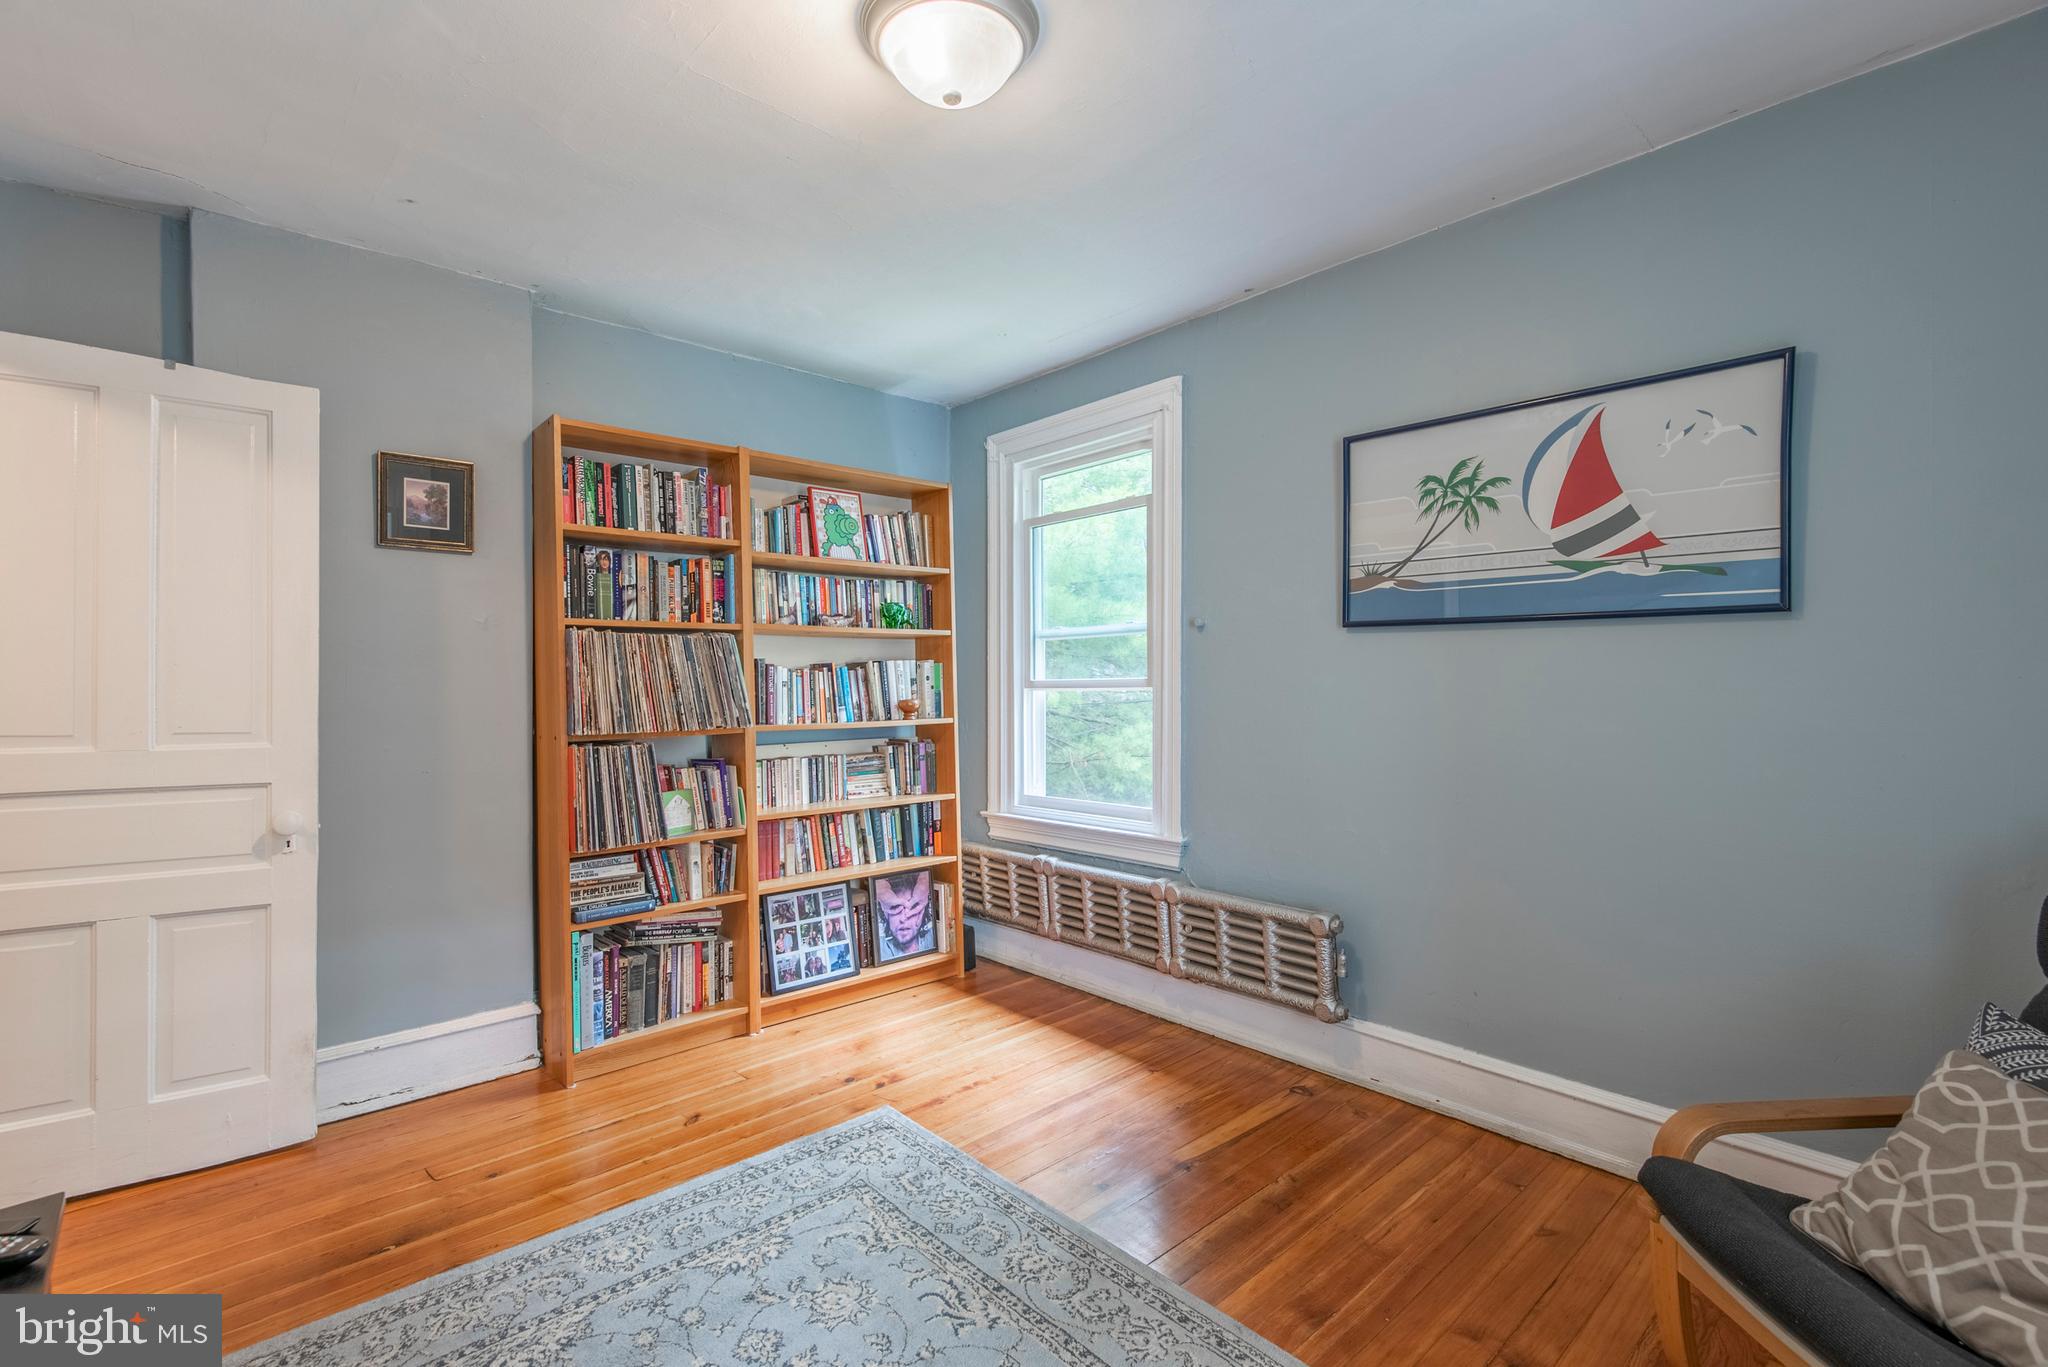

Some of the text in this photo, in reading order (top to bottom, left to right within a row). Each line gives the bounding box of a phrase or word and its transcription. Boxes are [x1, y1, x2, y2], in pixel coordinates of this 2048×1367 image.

[587, 568, 597, 596] Bowie
[583, 885, 610, 896] PEOPLE'S
[611, 881, 639, 892] ALMANAC
